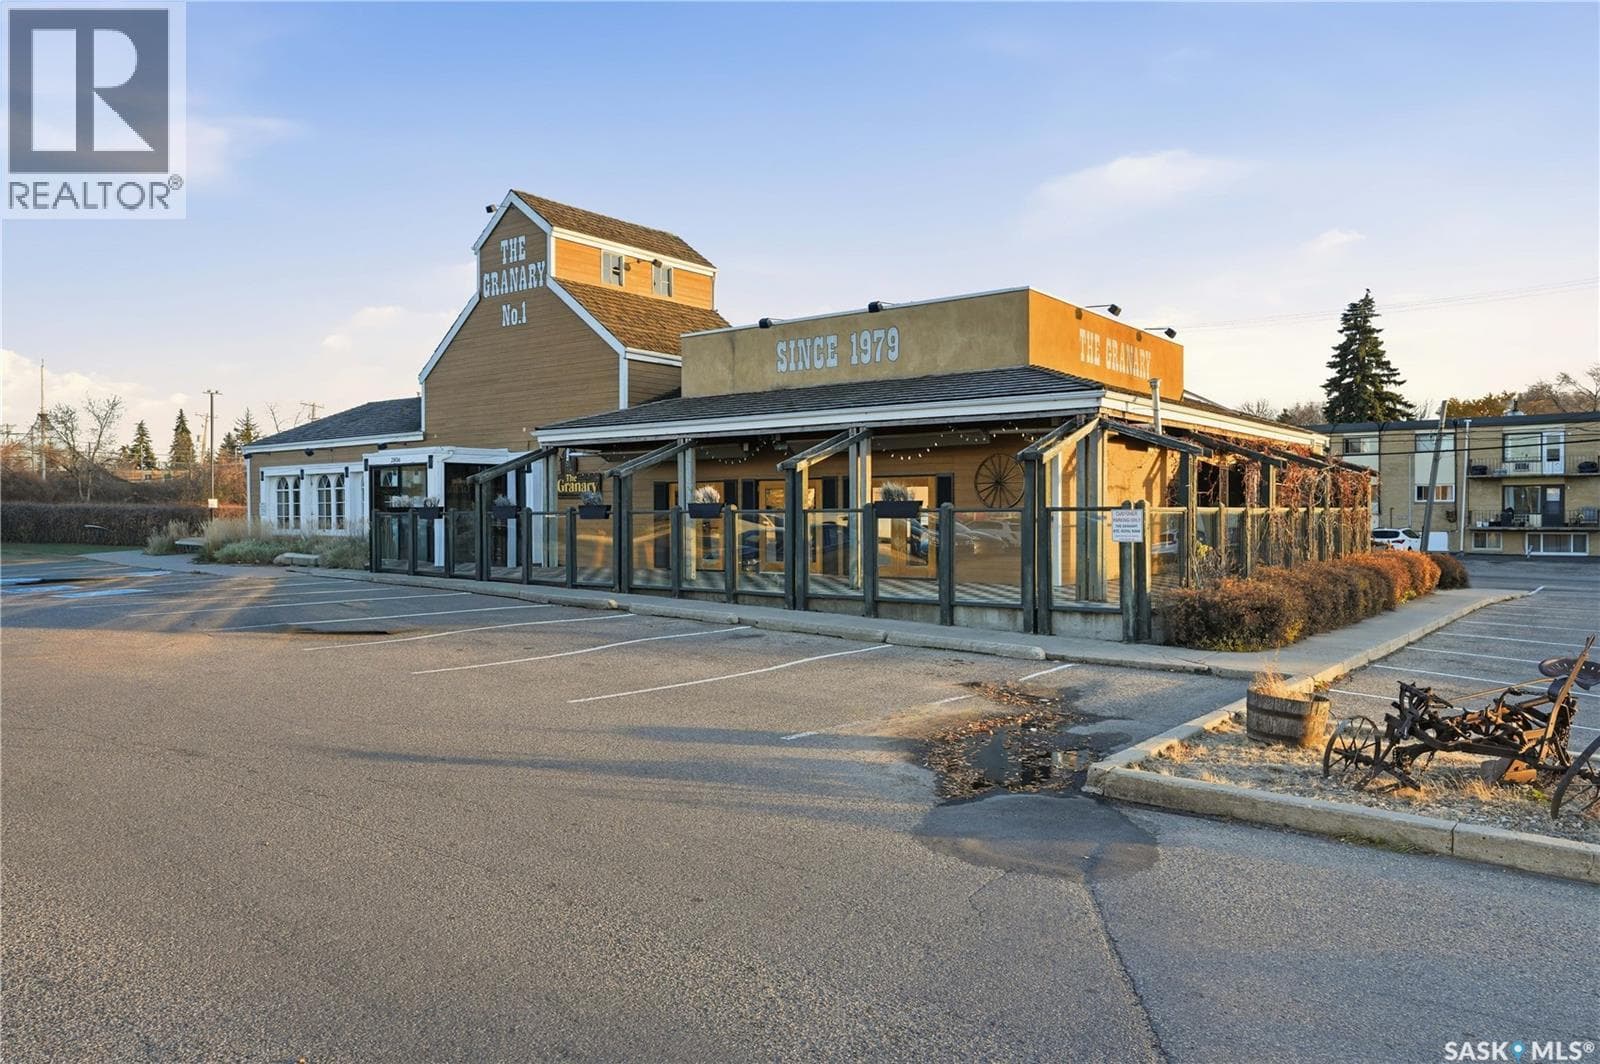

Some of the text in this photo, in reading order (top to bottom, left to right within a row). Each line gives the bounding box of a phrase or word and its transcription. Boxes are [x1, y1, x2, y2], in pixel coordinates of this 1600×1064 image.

[500, 235, 526, 265] THE
[483, 261, 545, 298] GRANARY
[502, 301, 527, 327] No.1
[776, 326, 899, 373] SINCE 1979
[1079, 327, 1152, 380] THE GRANARY
[557, 480, 597, 493] Granary
[566, 473, 577, 482] The
